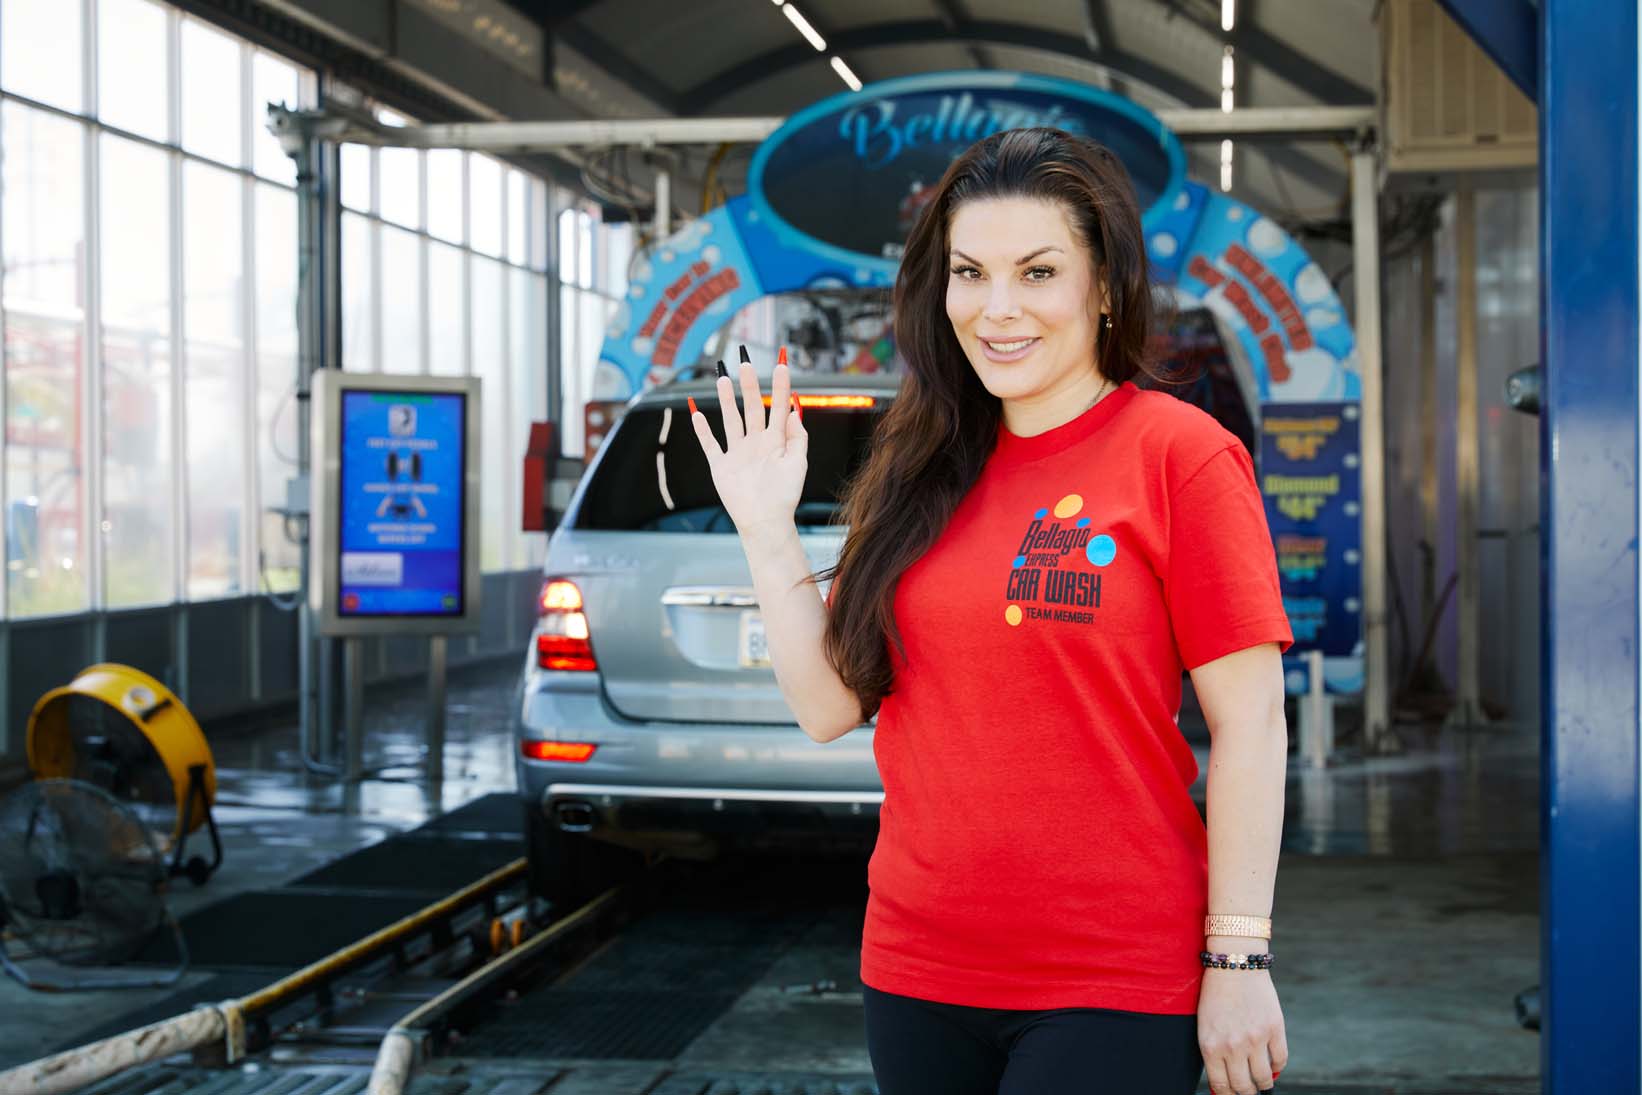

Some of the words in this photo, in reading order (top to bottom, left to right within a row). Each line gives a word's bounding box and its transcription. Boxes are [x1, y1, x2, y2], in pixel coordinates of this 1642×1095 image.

[1018, 519, 1091, 556] Bellagio
[1025, 553, 1060, 568] EXPRESS
[1006, 568, 1042, 601] CAR
[1044, 569, 1102, 609] WASH
[1025, 607, 1053, 621] TEAM
[1053, 609, 1094, 625] MEMBER
